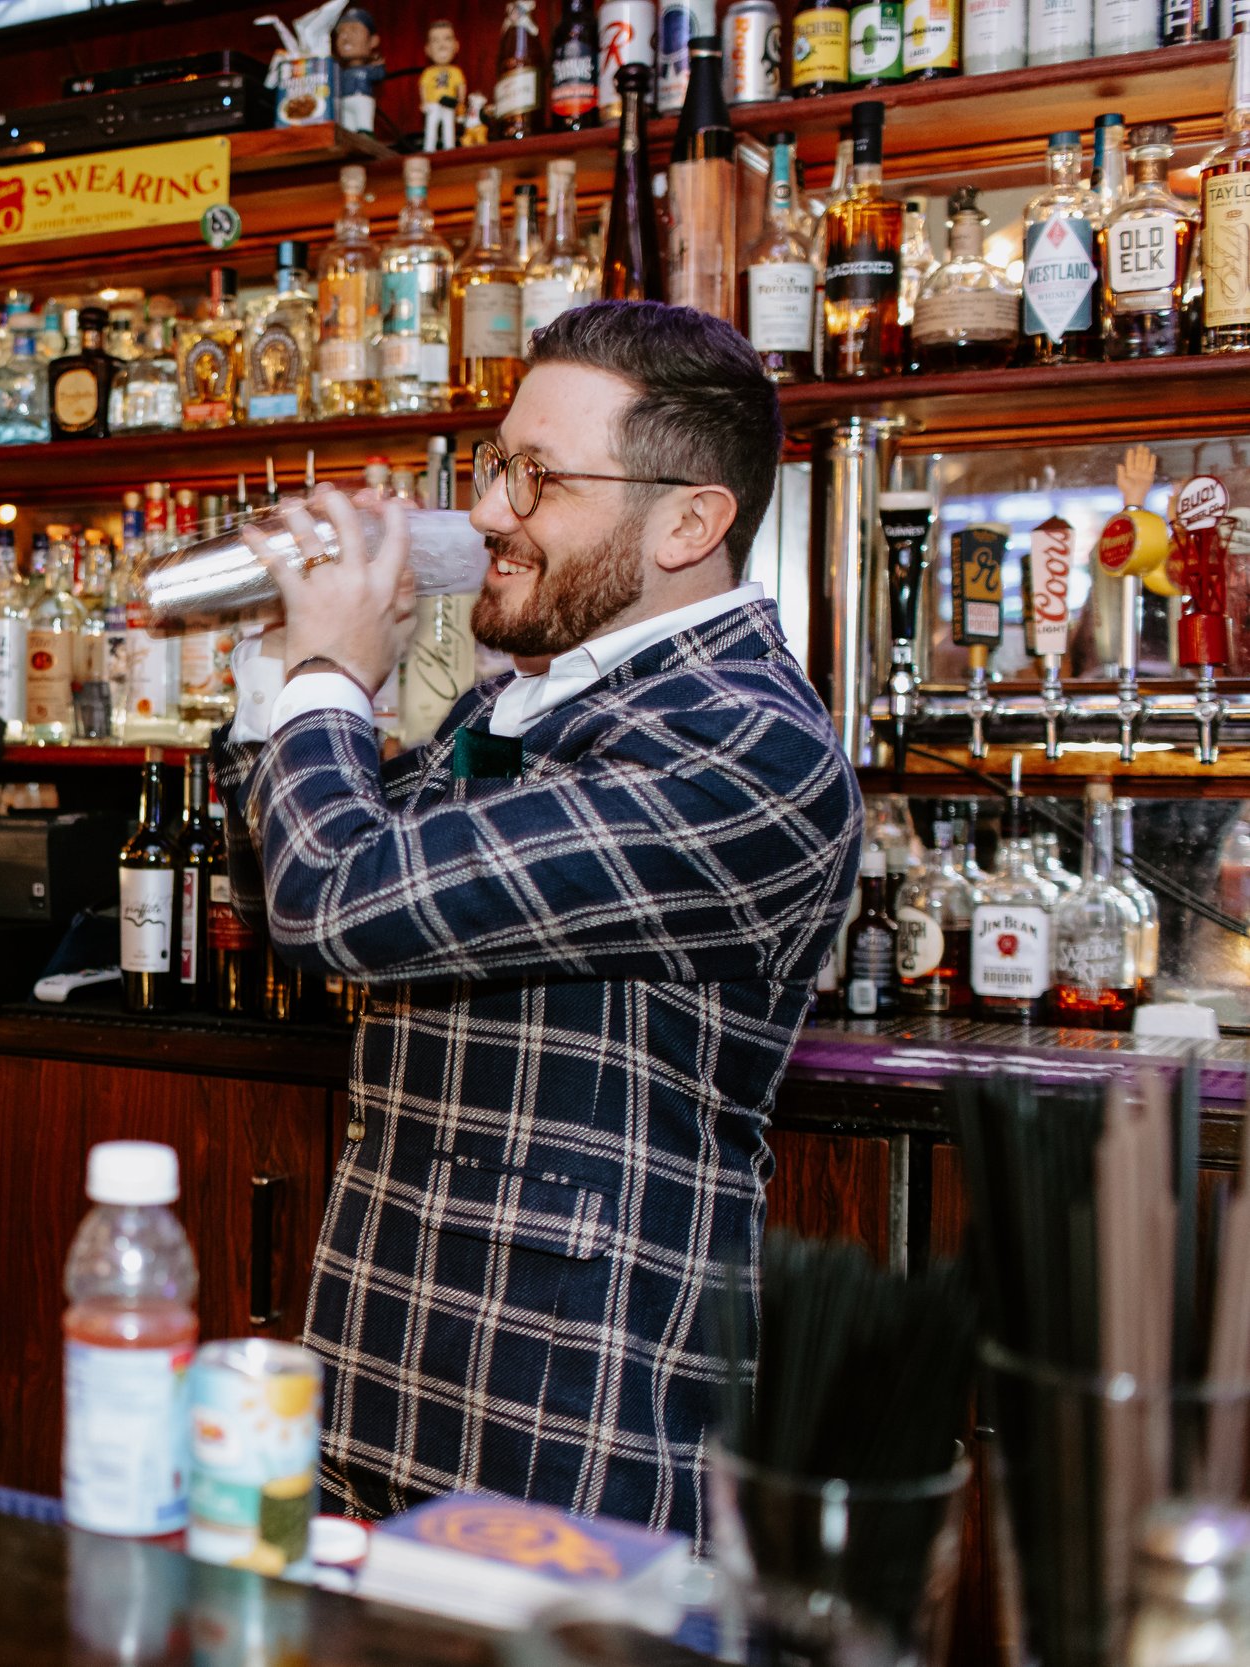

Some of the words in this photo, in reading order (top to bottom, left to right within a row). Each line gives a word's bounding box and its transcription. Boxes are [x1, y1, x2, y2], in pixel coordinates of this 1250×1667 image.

[32, 163, 221, 207] SWEARING
[1209, 184, 1250, 201] TAYLO
[1120, 226, 1165, 251] OLD
[1120, 249, 1166, 273] ELK
[1028, 263, 1091, 285] WESTLAND
[1037, 290, 1077, 301] WHISKEY
[1181, 481, 1220, 514] BUOY
[884, 525, 926, 538] GUINNESS
[1033, 529, 1070, 624] Coors
[1037, 625, 1066, 634] LIGHT
[979, 919, 1001, 938] JIM
[1004, 915, 1038, 940] BEAM
[1055, 939, 1122, 972] SAZERAC
[983, 972, 1033, 984] BOURBON
